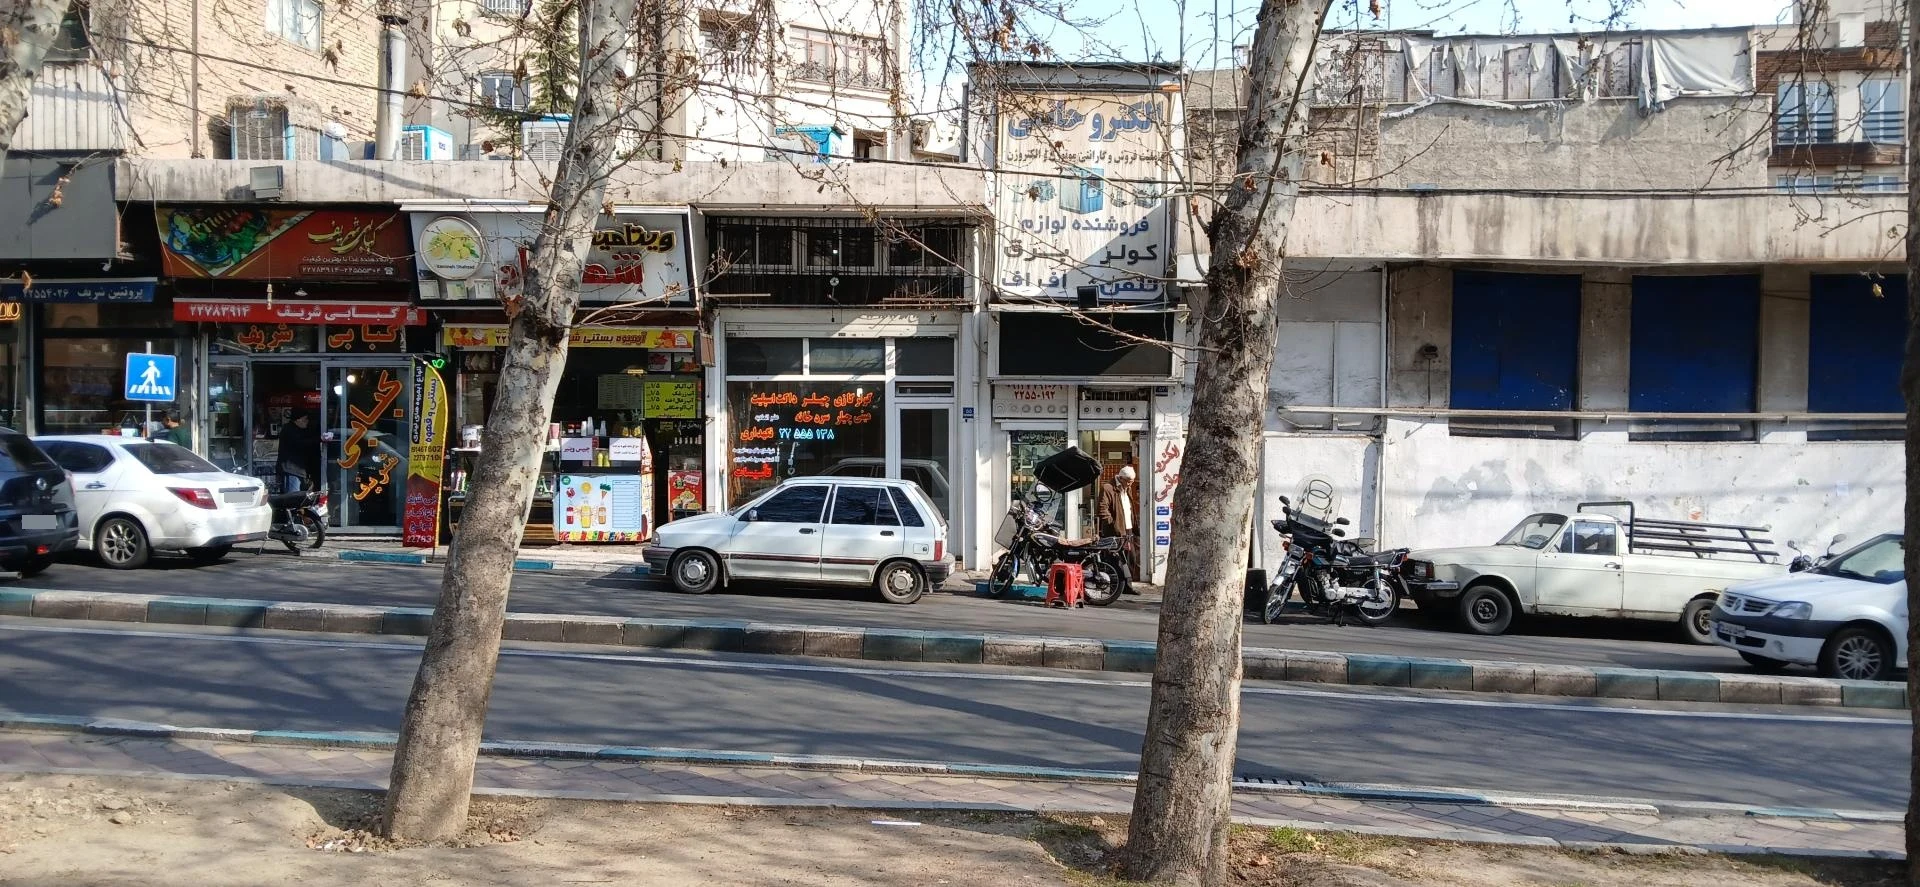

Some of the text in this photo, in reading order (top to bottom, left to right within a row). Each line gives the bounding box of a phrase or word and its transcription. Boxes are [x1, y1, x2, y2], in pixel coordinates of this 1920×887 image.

[1114, 150, 1137, 164] فروش
[308, 216, 361, 247] شریف
[1021, 215, 1149, 236] فروشنده لوازم
[1100, 244, 1157, 264] کولر
[77, 286, 105, 300] شریف
[189, 304, 401, 321] کبابی شریف ۲۲۷۸۳۹۱۴
[237, 322, 294, 350] شریف
[583, 333, 614, 345] بستنی
[428, 378, 440, 410] بستنی
[751, 392, 776, 408] اسپلیت
[775, 391, 798, 404] داکت
[801, 392, 831, 408] چیلر
[834, 392, 856, 408] گازی
[336, 369, 403, 469] کبابی
[835, 410, 853, 425] چیلر
[853, 410, 872, 424] مینی
[424, 418, 436, 443] قهوه
[740, 426, 775, 441] نگهداری
[353, 452, 399, 501] شریف
